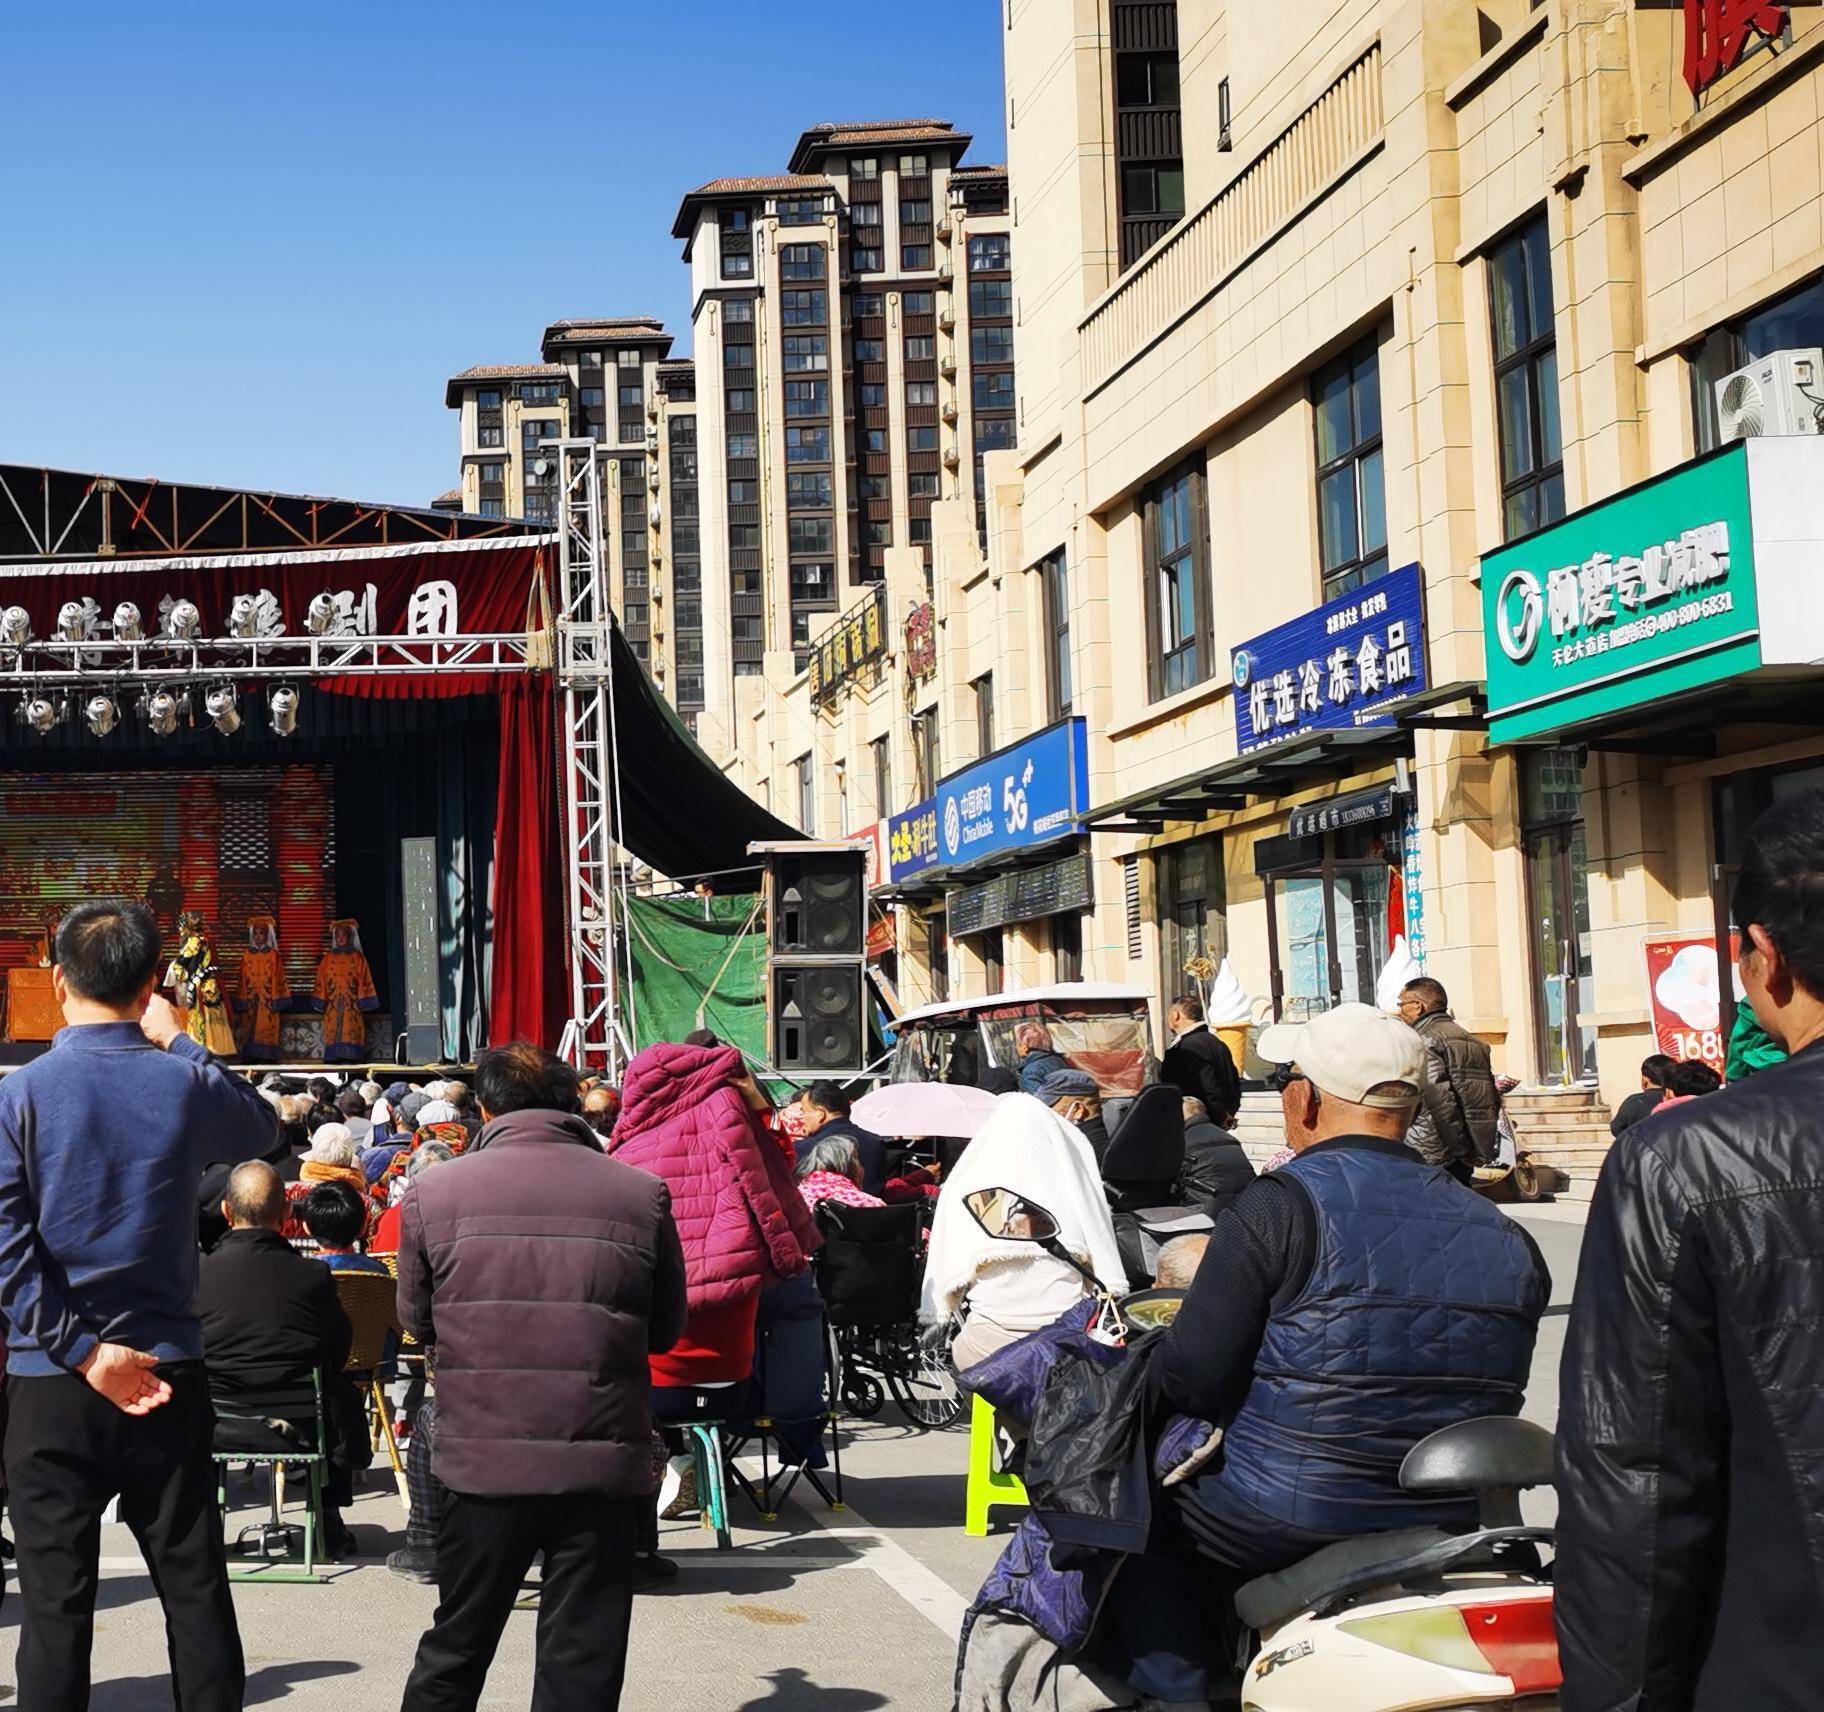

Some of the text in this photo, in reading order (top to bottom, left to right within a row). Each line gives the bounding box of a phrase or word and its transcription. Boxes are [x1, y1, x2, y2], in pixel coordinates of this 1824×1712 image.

[1249, 620, 1412, 735] 优选冷冻食品
[961, 782, 992, 820] 中国移动
[1672, 1030, 1725, 1060] 168
